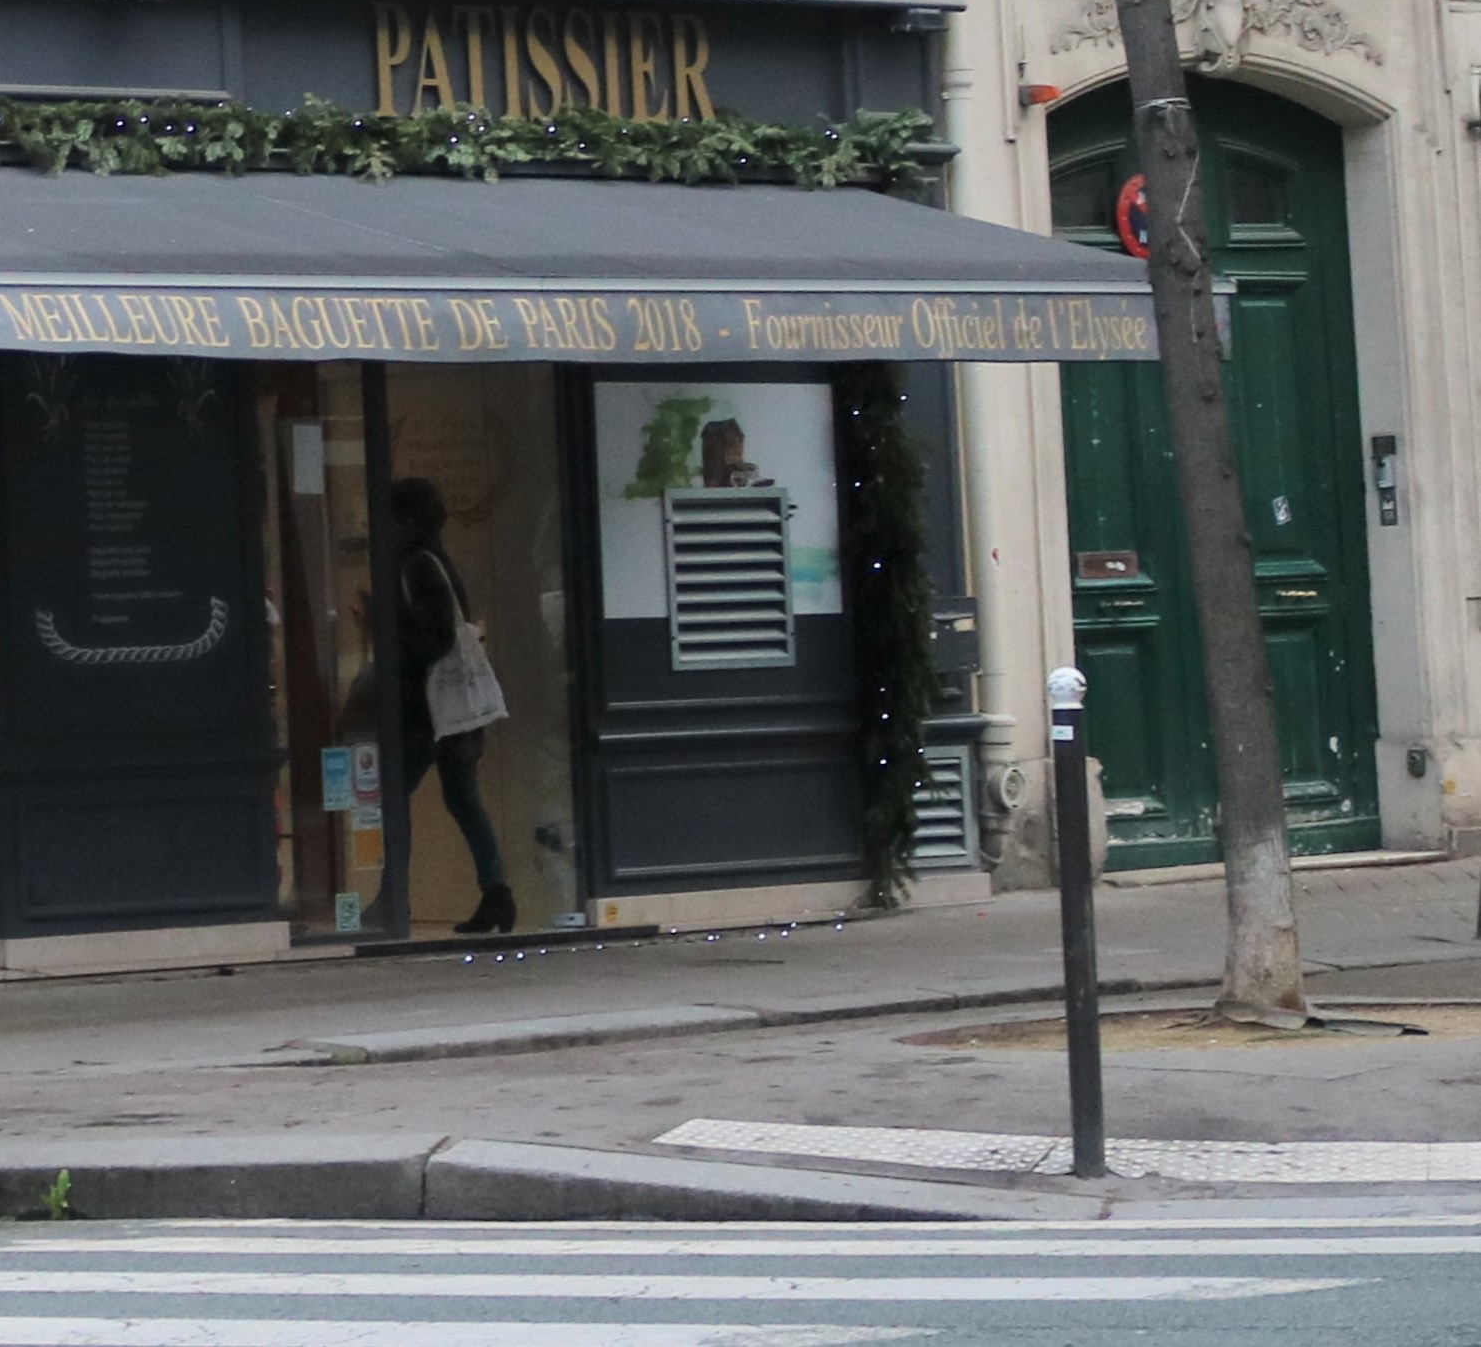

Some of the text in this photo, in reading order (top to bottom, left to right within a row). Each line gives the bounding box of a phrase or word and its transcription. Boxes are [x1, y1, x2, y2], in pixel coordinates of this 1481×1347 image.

[374, 2, 719, 121] PATISSIER
[235, 296, 439, 350] BAGUETTE
[448, 298, 508, 351] DE
[514, 297, 617, 351] PARIS
[627, 298, 702, 352] 2018
[743, 298, 904, 350] Fournisseur
[912, 297, 1006, 359] Officiel
[1013, 300, 1041, 350] de
